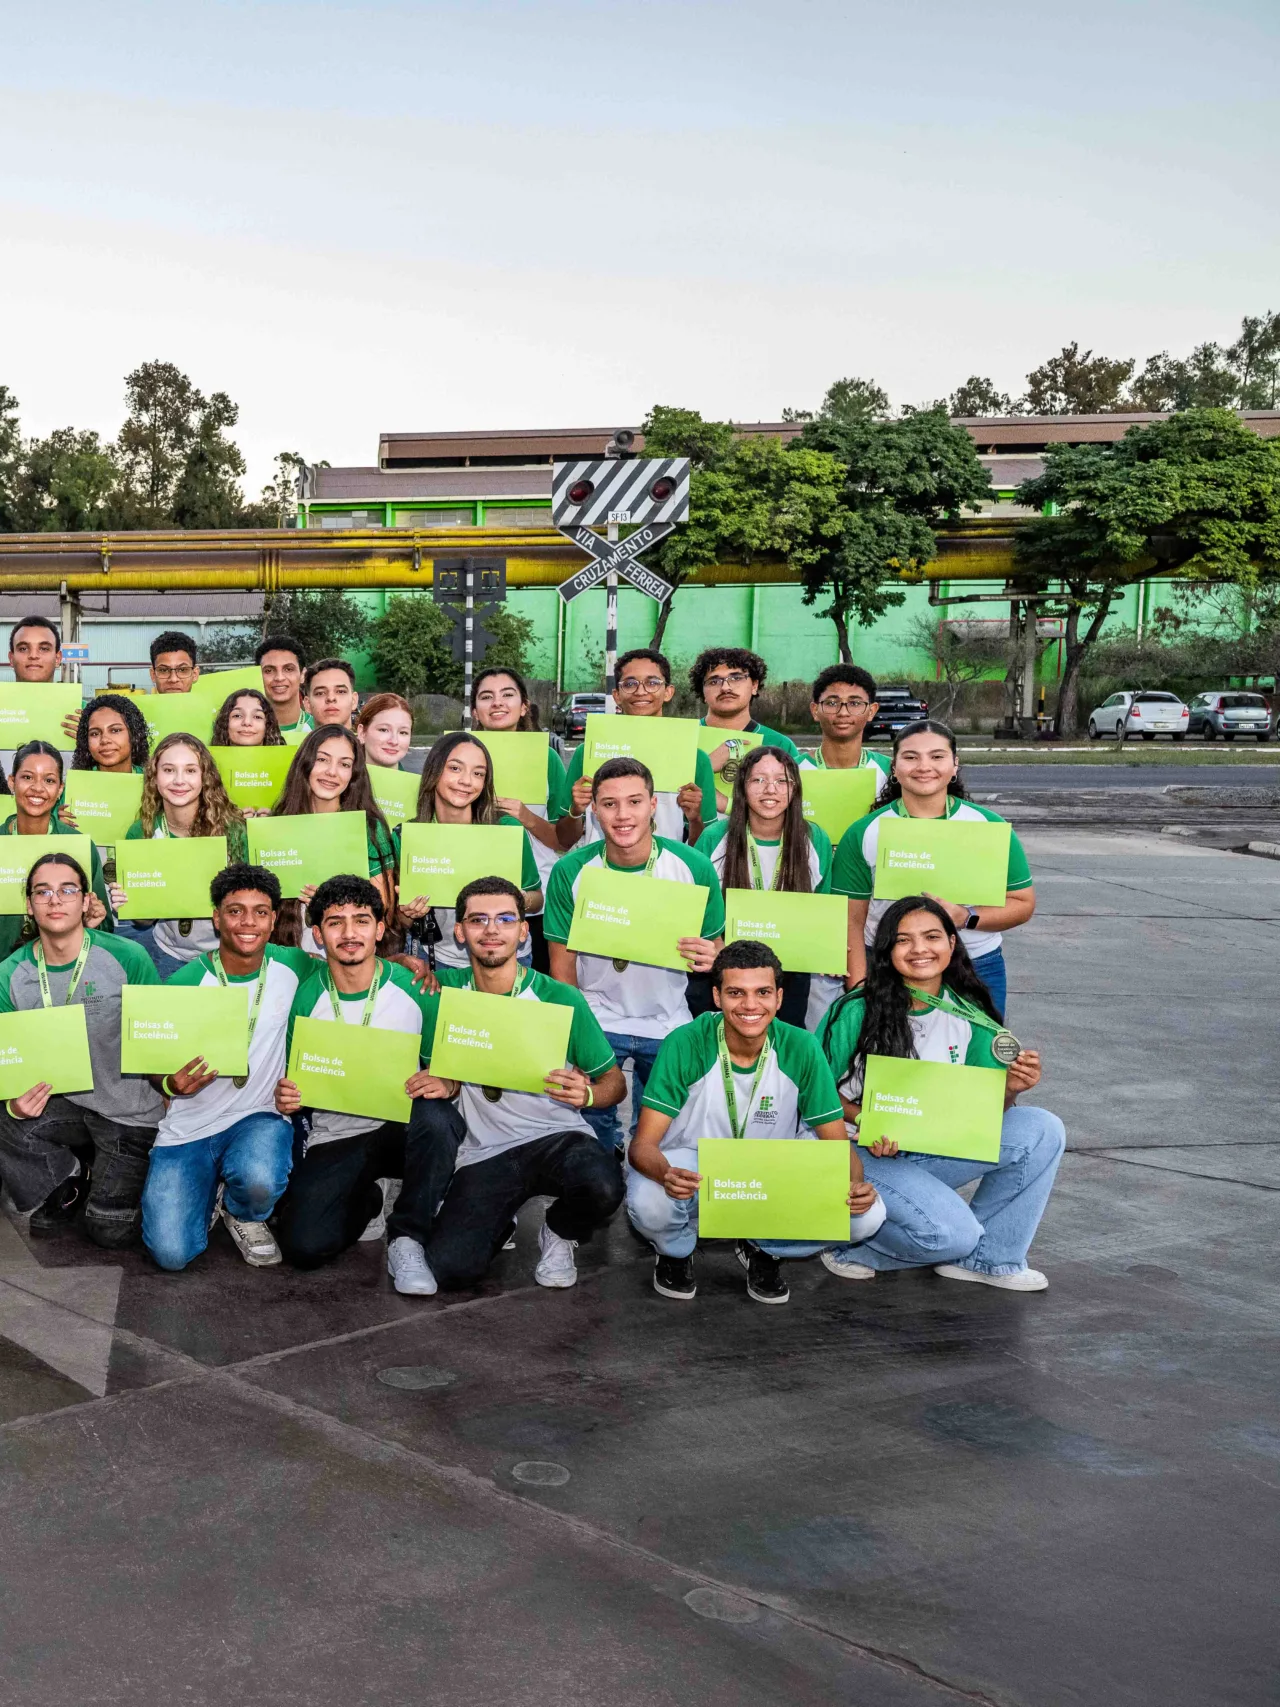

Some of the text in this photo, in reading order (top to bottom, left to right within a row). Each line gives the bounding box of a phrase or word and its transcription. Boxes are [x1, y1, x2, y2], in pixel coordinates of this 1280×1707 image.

[612, 514, 627, 522] SF13
[576, 528, 595, 549] VIA
[574, 530, 653, 590] CRUZAMENTO
[17, 708, 26, 716] de
[595, 742, 620, 750] Bolsas
[235, 771, 269, 779] Bolsas de
[235, 778, 272, 787] Excelência
[75, 800, 96, 808] Bolsas
[74, 808, 112, 818] Excelência
[260, 848, 298, 858] Bolsas de
[750, 846, 758, 867] USIMINAS
[890, 850, 931, 860] Bolsas de
[260, 857, 302, 868] Excelência
[412, 856, 438, 864] Bolsas
[888, 859, 936, 870] Excelência
[127, 870, 162, 879] Bolsas de
[412, 865, 454, 874] Excelência
[127, 880, 166, 888] Excelência
[588, 901, 628, 915] Bolsas de
[586, 910, 630, 926] Excelência
[737, 920, 776, 930] Bolsas de
[737, 928, 780, 939] Excelência
[256, 983, 264, 1006] USIMINAS
[370, 978, 378, 1002] USIMINAS
[952, 1008, 975, 1019] USIMINAS
[134, 1021, 174, 1029] Bolsas de
[133, 1030, 178, 1040] Excelência
[449, 1024, 490, 1039] Bolsas de
[447, 1034, 493, 1050] Excelência
[7, 1046, 18, 1055] de
[302, 1052, 343, 1066] Bolsas de
[301, 1062, 346, 1076] Excelência
[876, 1092, 919, 1105] Bolsas de
[874, 1102, 923, 1116] Excelência
[713, 1178, 762, 1189] Bolsas de
[713, 1190, 768, 1201] Excelência
